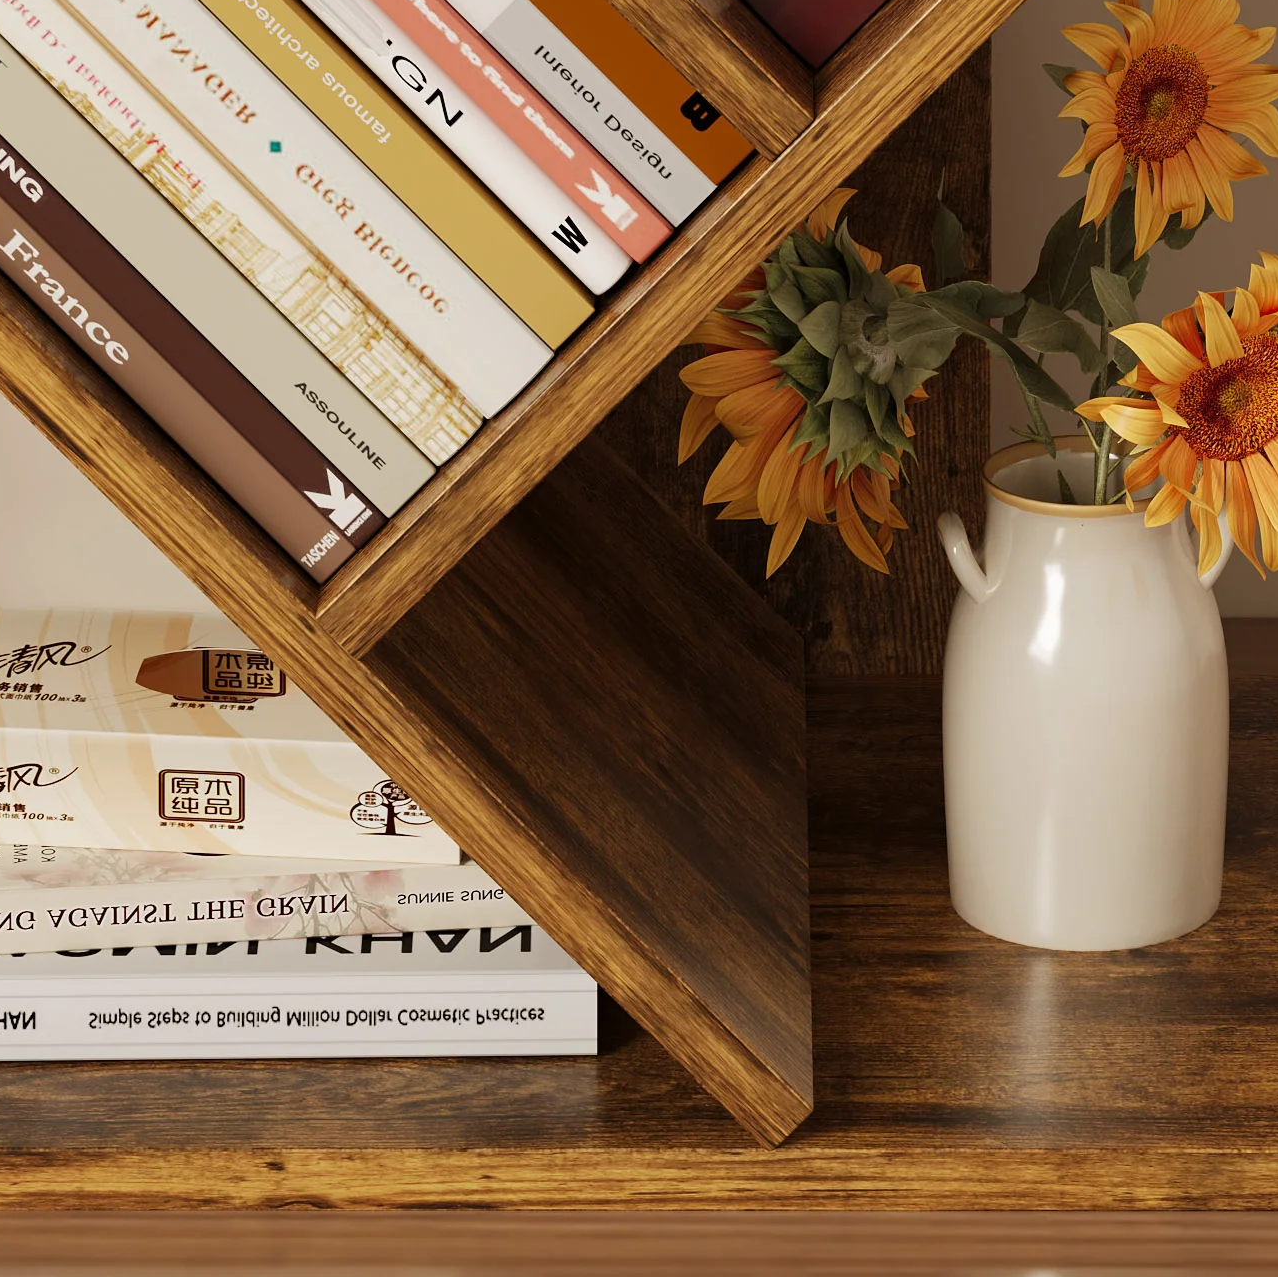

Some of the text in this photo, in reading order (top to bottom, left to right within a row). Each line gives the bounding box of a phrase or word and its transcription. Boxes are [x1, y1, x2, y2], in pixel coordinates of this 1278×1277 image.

[321, 71, 390, 142] famous
[293, 383, 386, 471] ASSOULINE
[299, 529, 340, 570] TASCHEN
